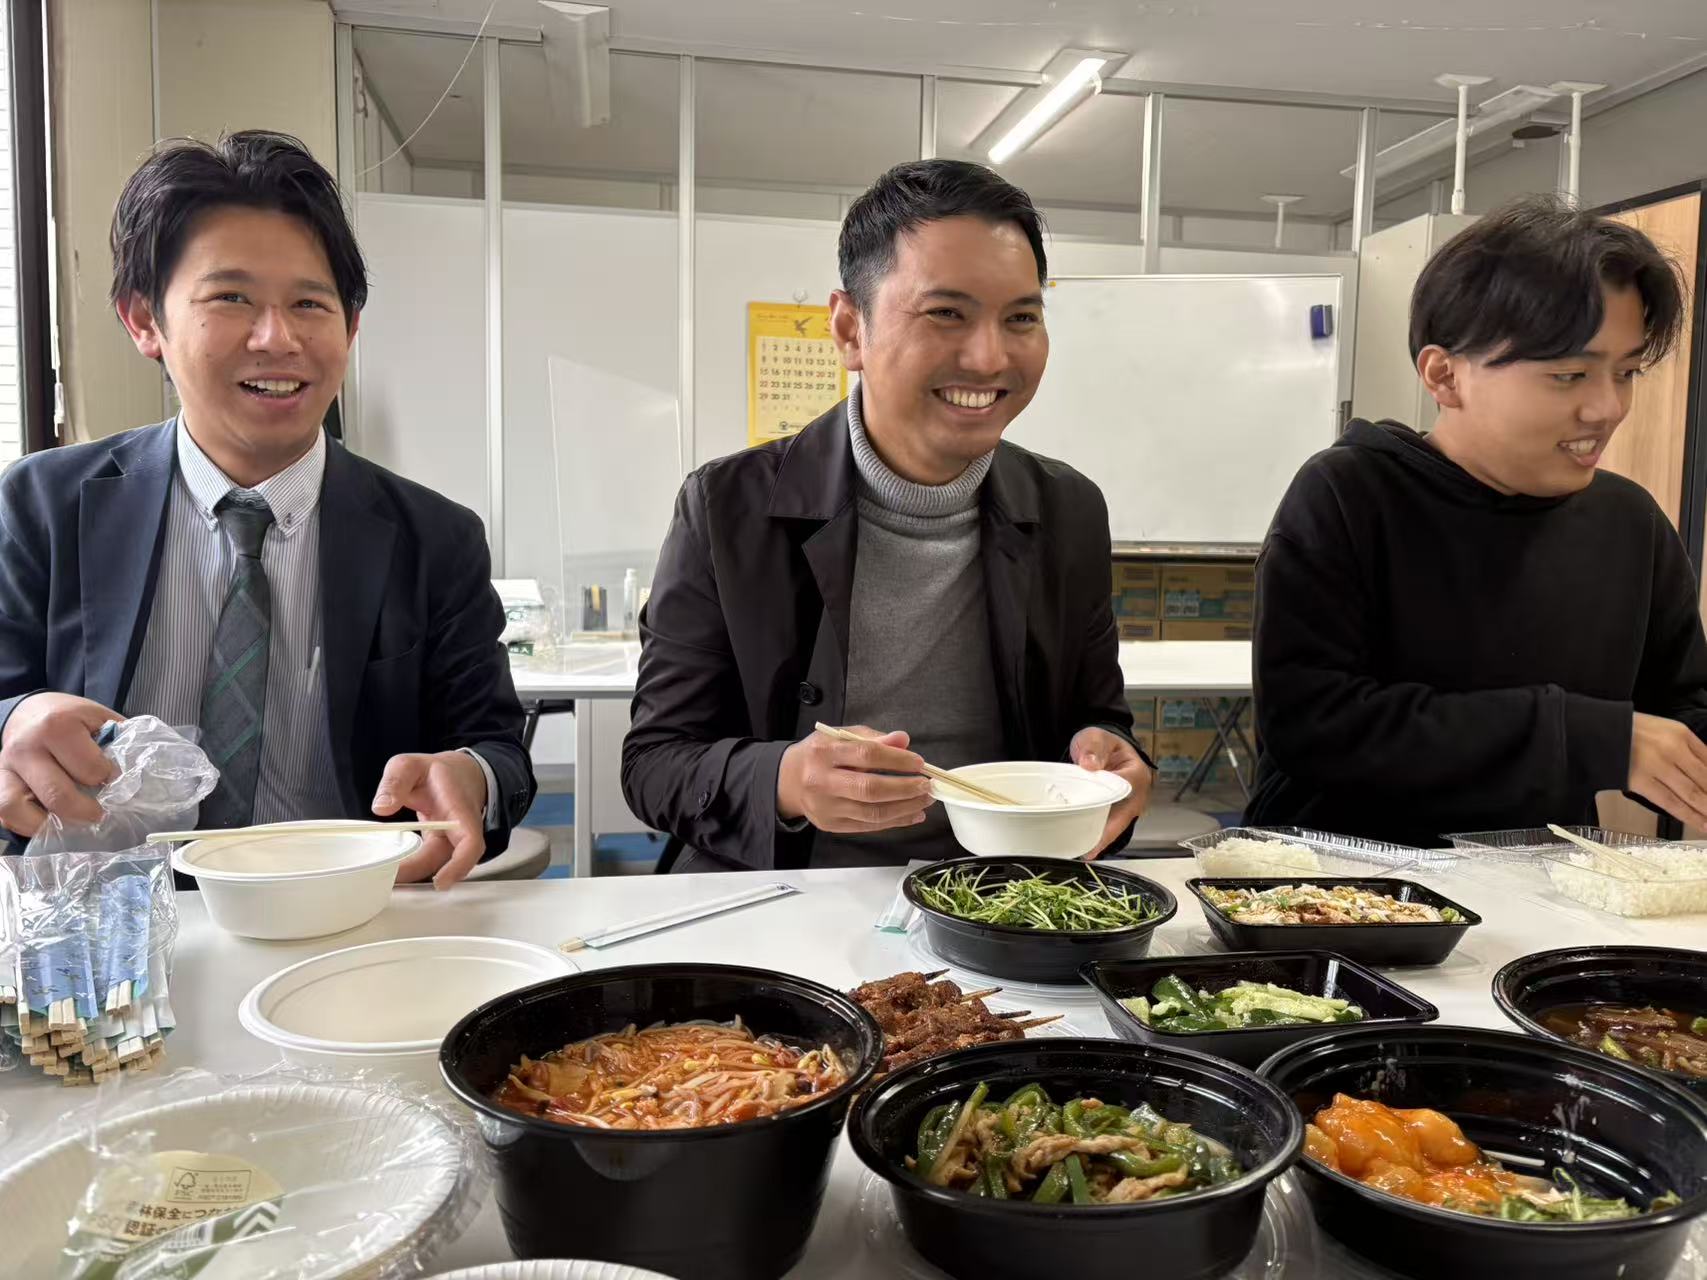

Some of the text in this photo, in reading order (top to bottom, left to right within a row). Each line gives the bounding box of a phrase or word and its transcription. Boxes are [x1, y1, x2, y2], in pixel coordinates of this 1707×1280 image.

[794, 369, 802, 377] 18
[816, 370, 826, 378] 20
[760, 380, 769, 388] 22
[782, 381, 791, 389] 24
[804, 382, 814, 390] 26
[782, 393, 791, 401] 31
